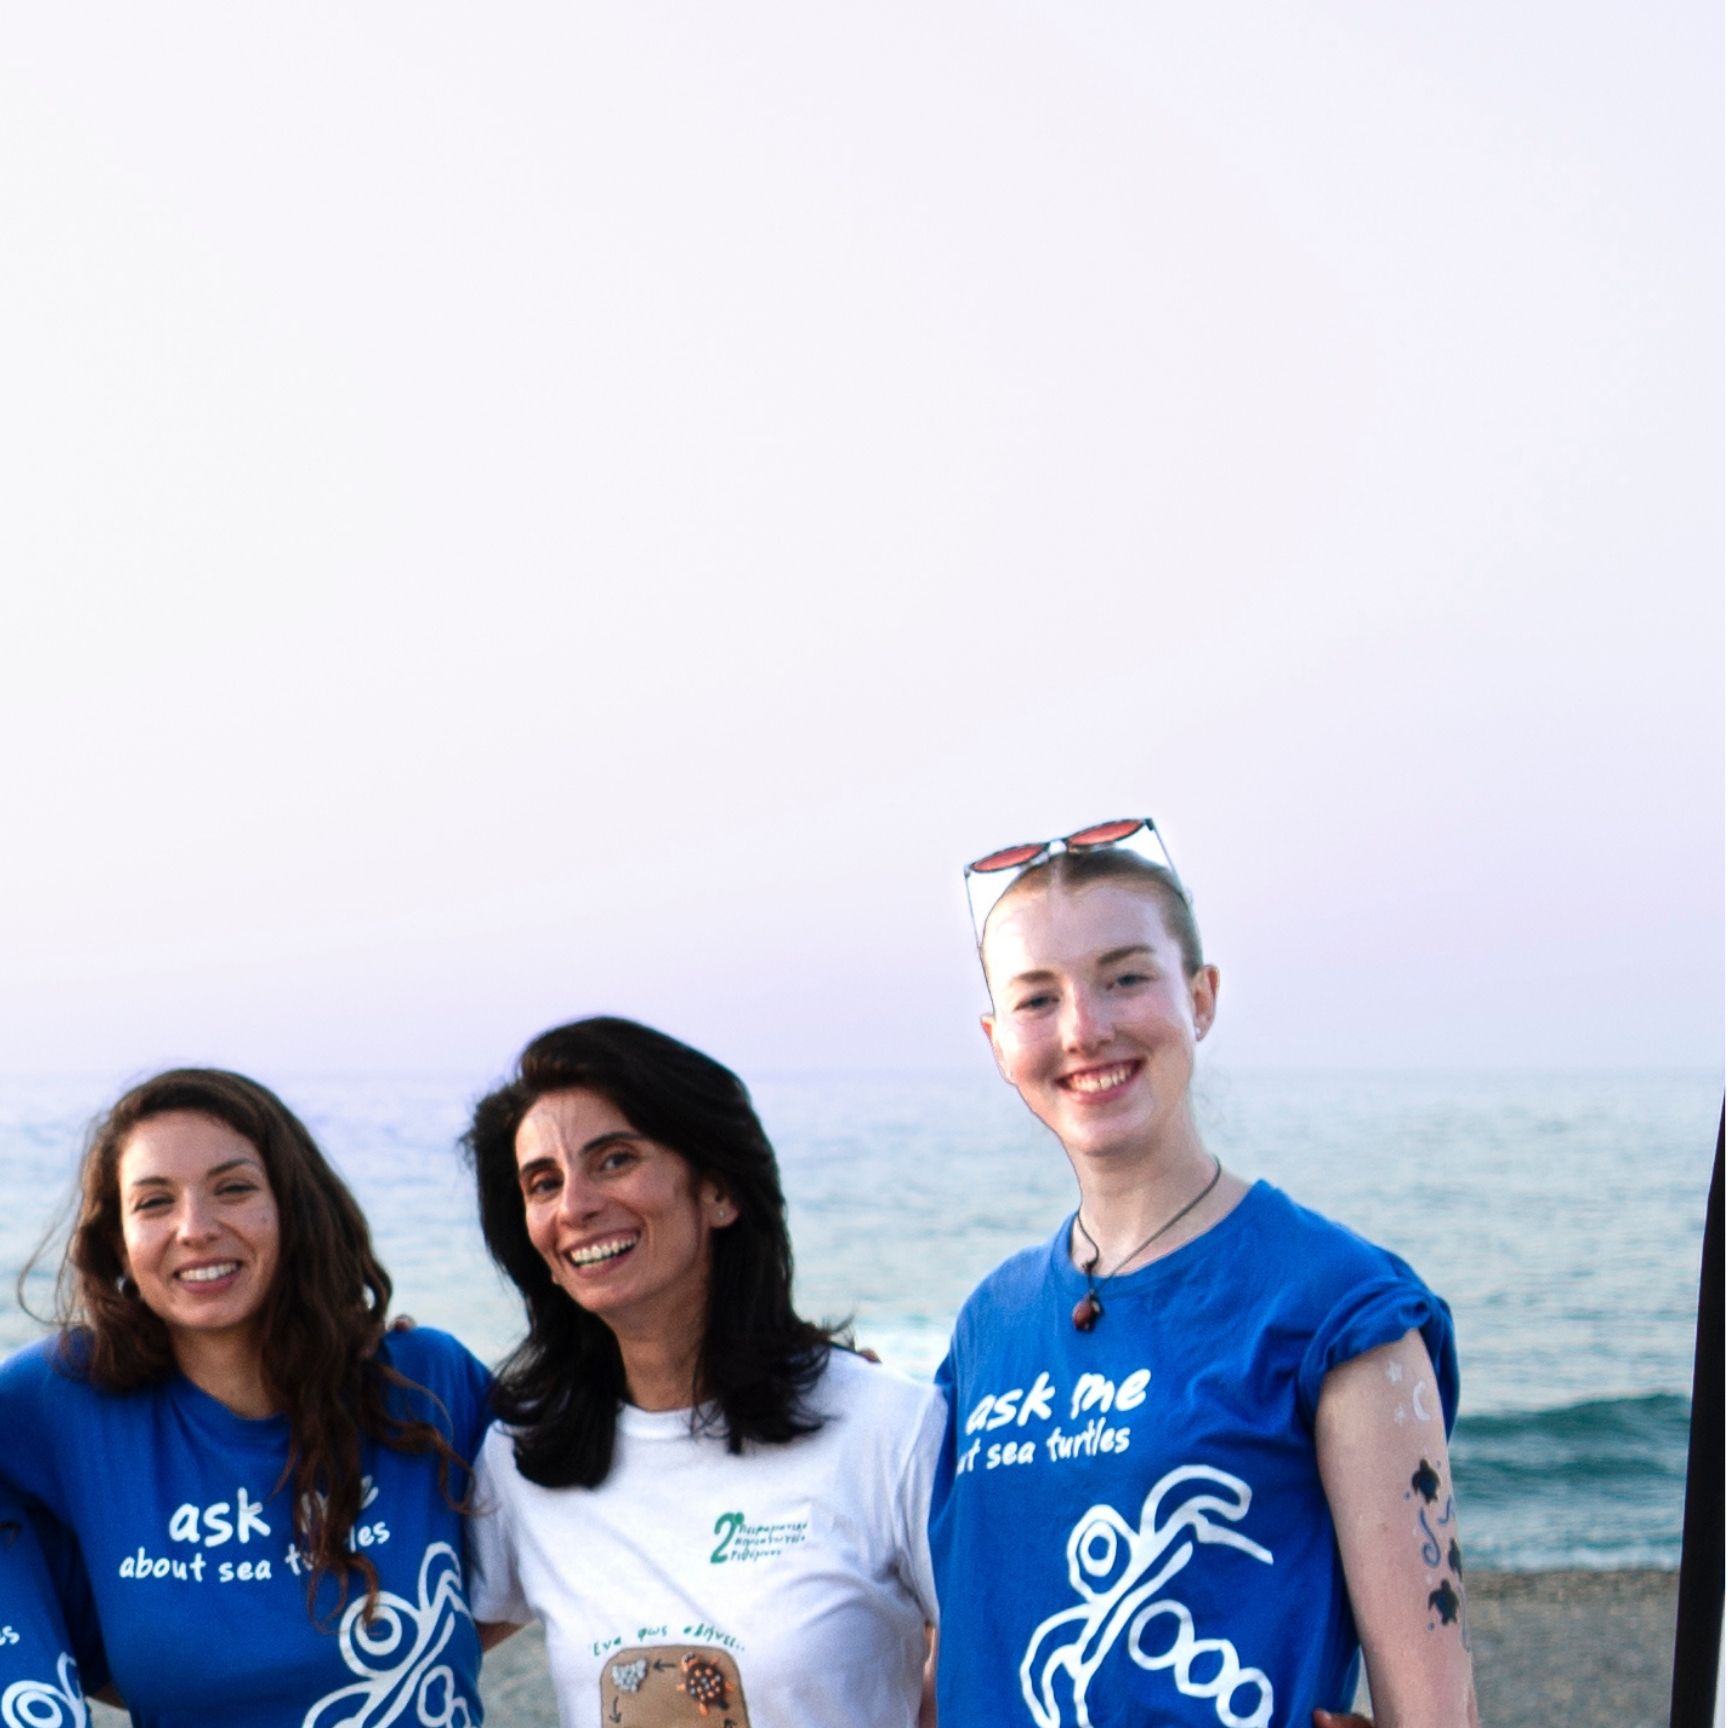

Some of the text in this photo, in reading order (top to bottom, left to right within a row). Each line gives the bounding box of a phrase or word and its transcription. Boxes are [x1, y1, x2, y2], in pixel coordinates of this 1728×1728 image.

[965, 1368, 1152, 1436] ask me
[986, 1441, 1036, 1470] sea
[1046, 1416, 1131, 1463] turtles
[169, 1487, 271, 1548] ask
[118, 1521, 391, 1583] about sea tules
